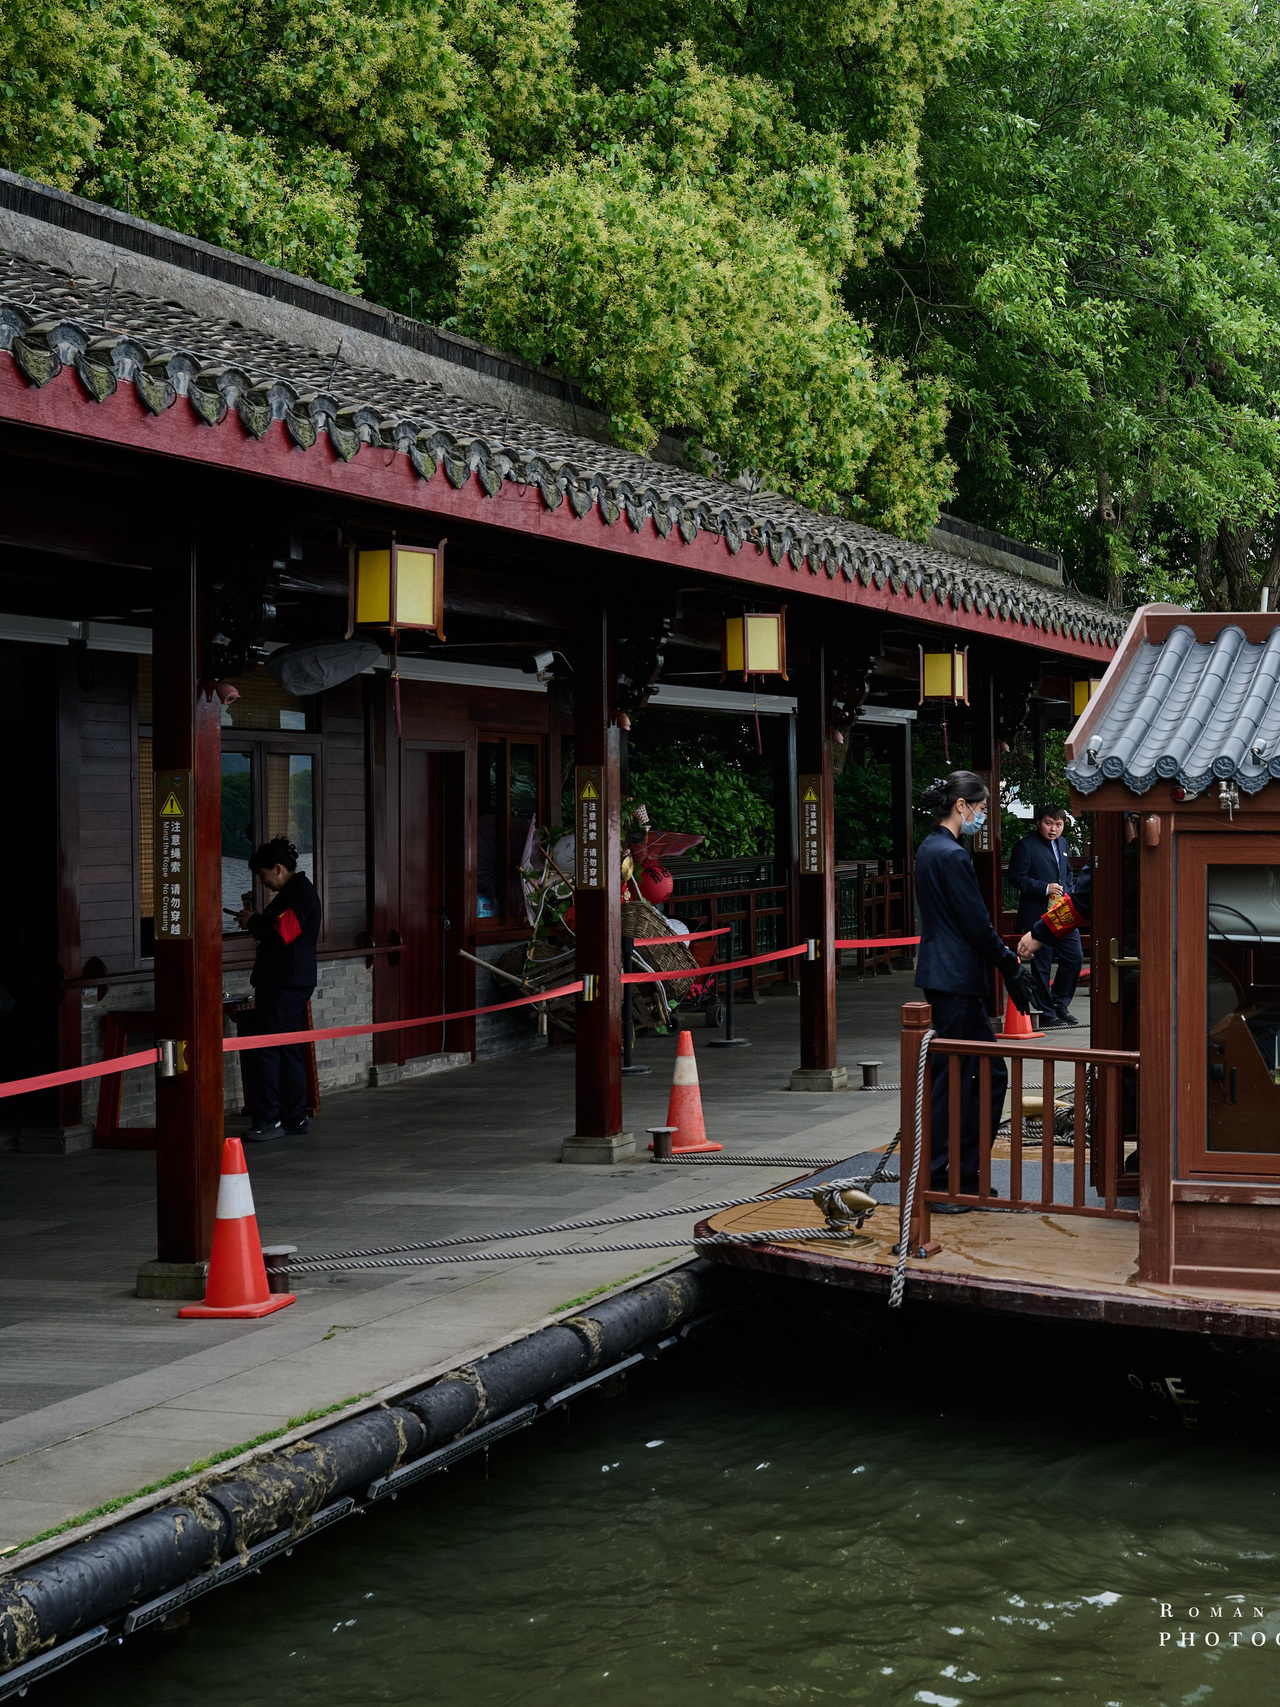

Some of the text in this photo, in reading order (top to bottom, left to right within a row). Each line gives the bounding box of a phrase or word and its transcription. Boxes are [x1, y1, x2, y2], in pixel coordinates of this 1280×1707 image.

[589, 802, 597, 886] 注意绳索 请勿穿越
[163, 883, 169, 895] No
[170, 820, 181, 935] 注意绳索 请勿穿越
[161, 896, 169, 931] Crossing
